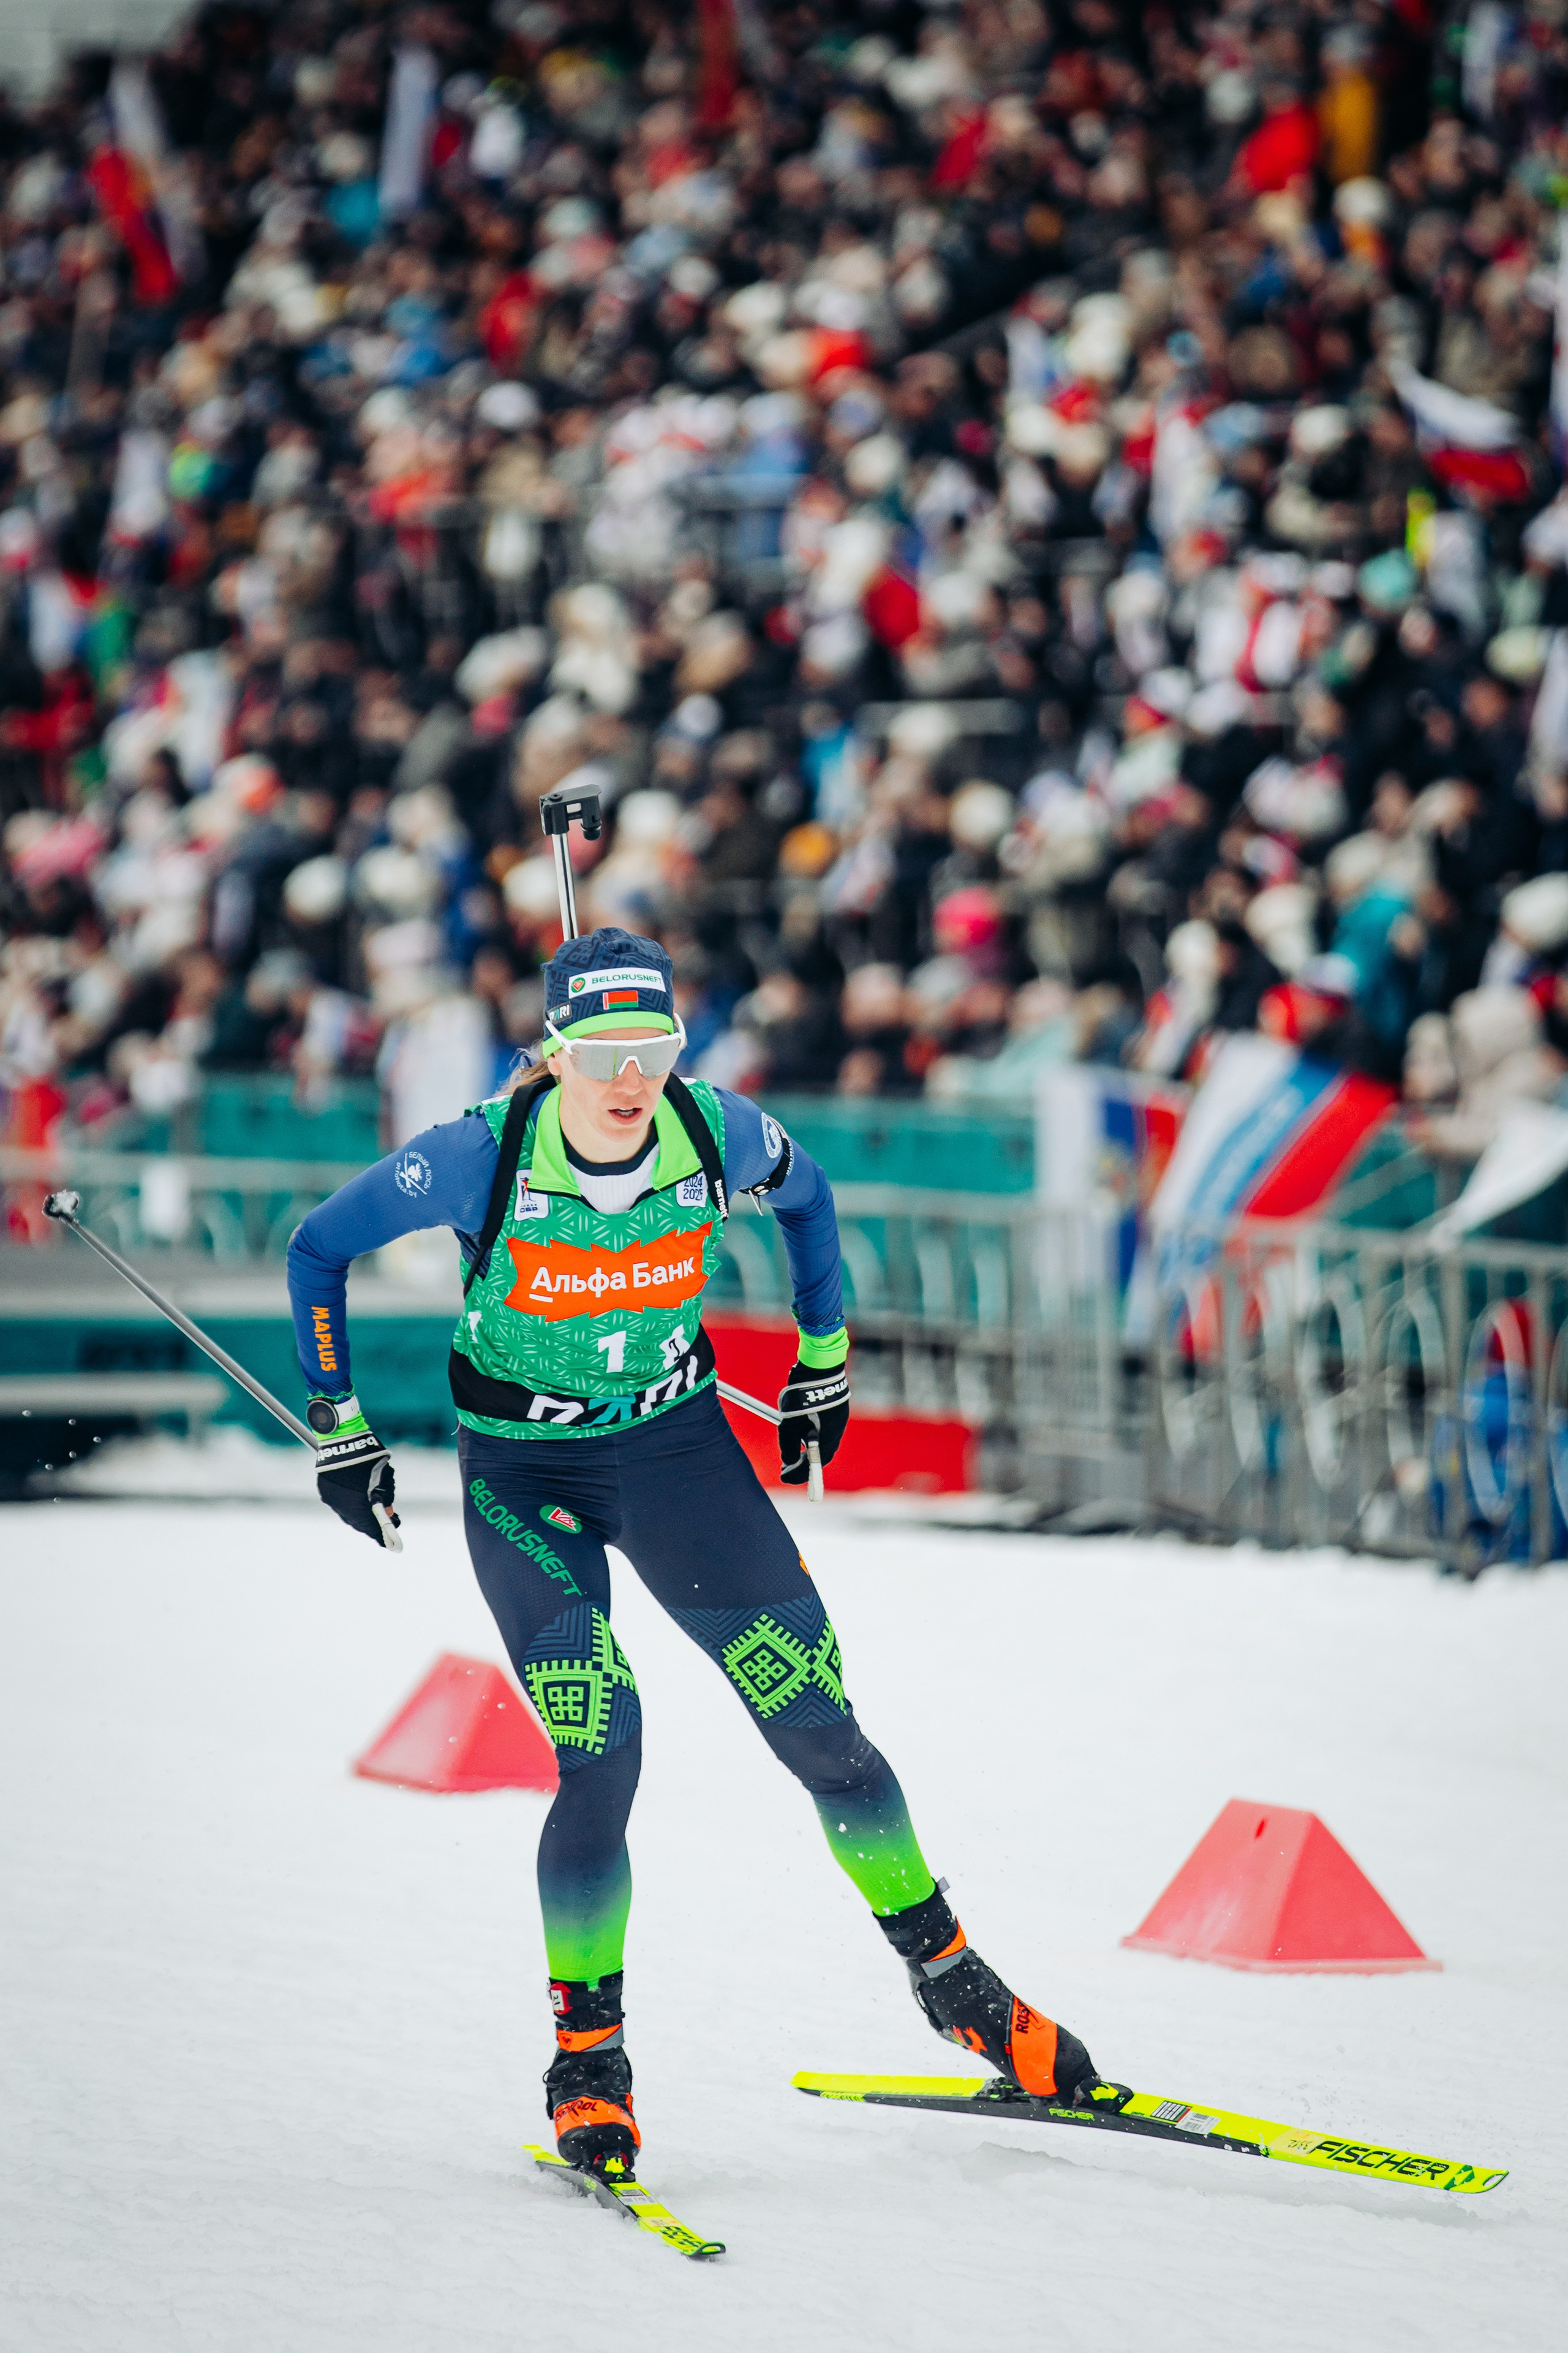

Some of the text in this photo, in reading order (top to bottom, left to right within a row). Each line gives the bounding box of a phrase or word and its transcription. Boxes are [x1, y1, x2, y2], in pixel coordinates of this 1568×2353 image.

[592, 973, 662, 984] BELORUSNEFT
[530, 1256, 695, 1298] Альфа Банк
[311, 1305, 337, 1372] MAPLUS
[597, 1330, 627, 1373] 1
[469, 1478, 582, 1596] BELORUSNEFT
[1048, 2107, 1096, 2121] FISCHER
[1308, 2140, 1450, 2181] FISCHER
